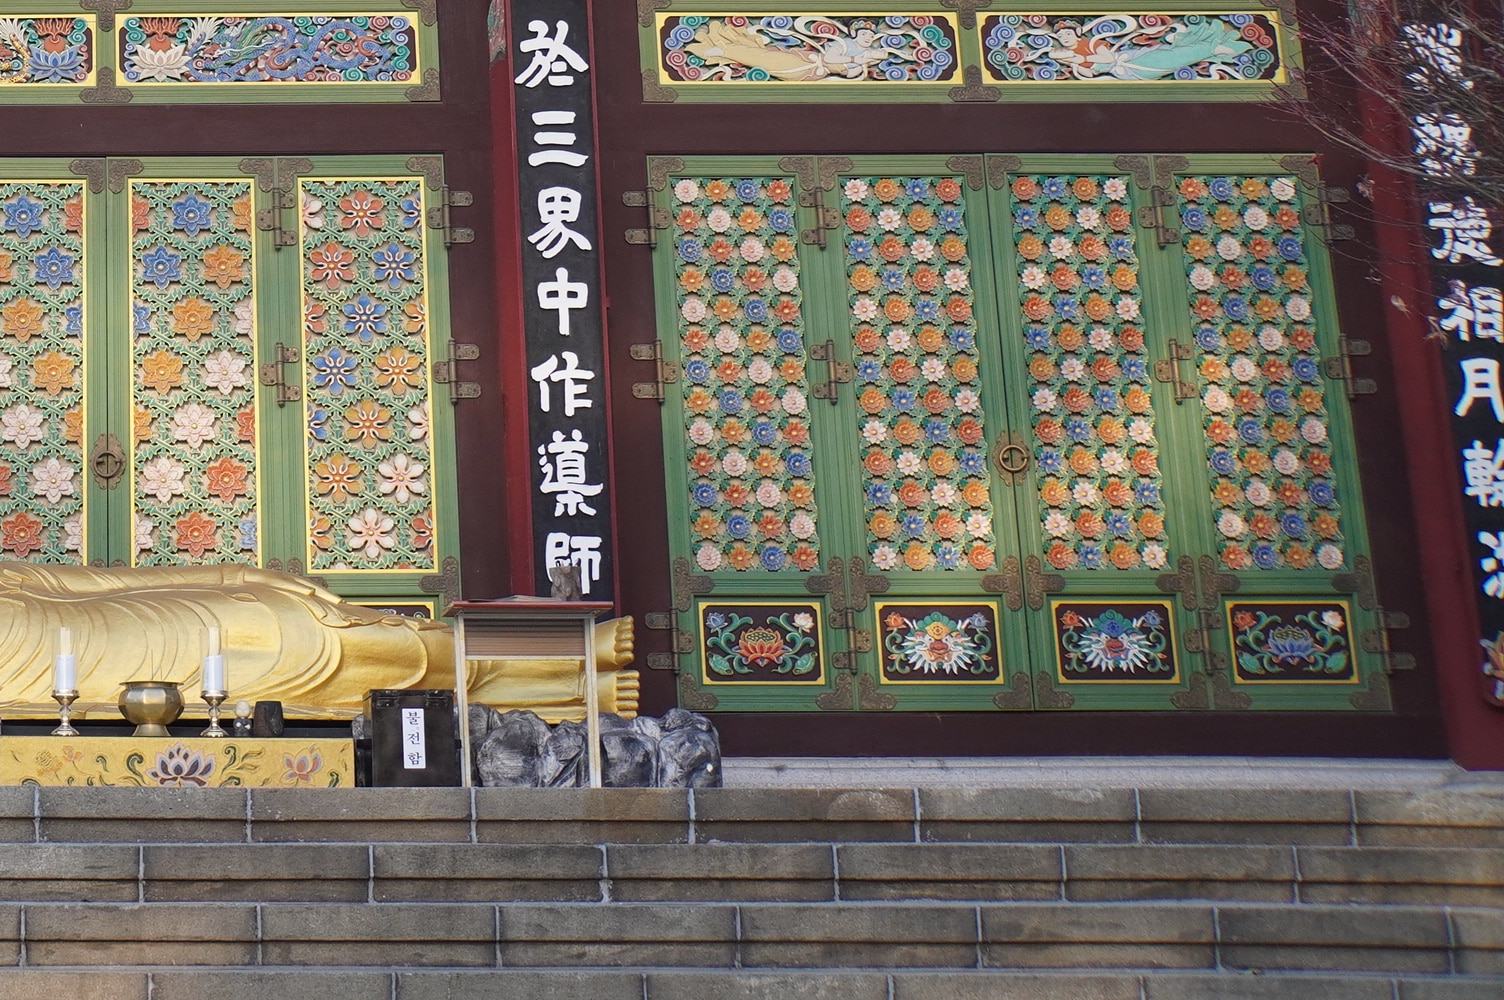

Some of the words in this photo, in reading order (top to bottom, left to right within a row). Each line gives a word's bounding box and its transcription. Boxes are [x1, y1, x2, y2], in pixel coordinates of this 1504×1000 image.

[515, 19, 604, 595] 於三界中作導師
[406, 711, 423, 766] 불전함
